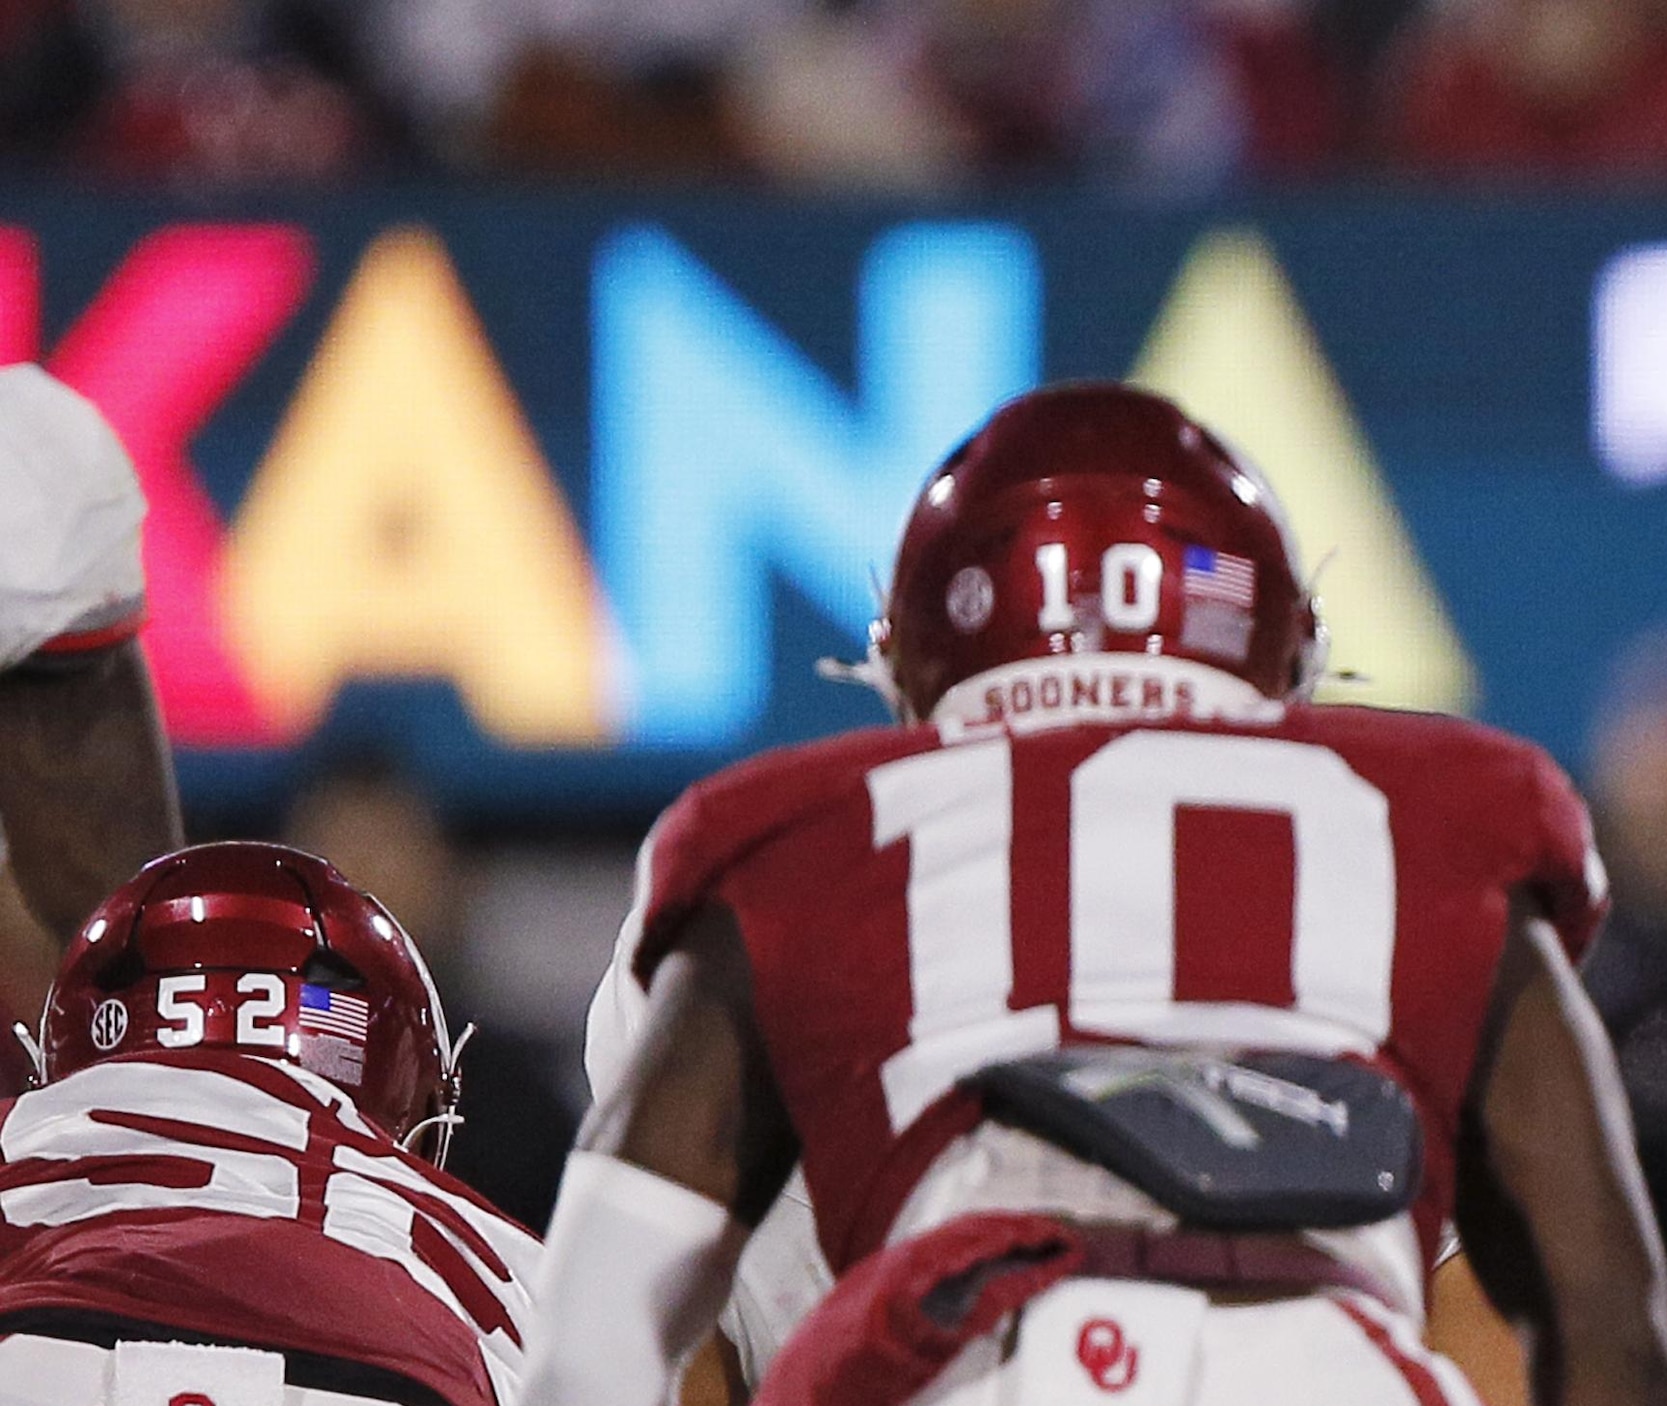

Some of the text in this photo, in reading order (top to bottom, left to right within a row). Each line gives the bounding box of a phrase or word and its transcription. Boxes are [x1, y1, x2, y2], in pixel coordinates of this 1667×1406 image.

[1034, 542, 1163, 632] 10
[984, 672, 1198, 720] SOONERS
[865, 729, 1397, 1137] 10
[92, 972, 287, 1049] SEC 52
